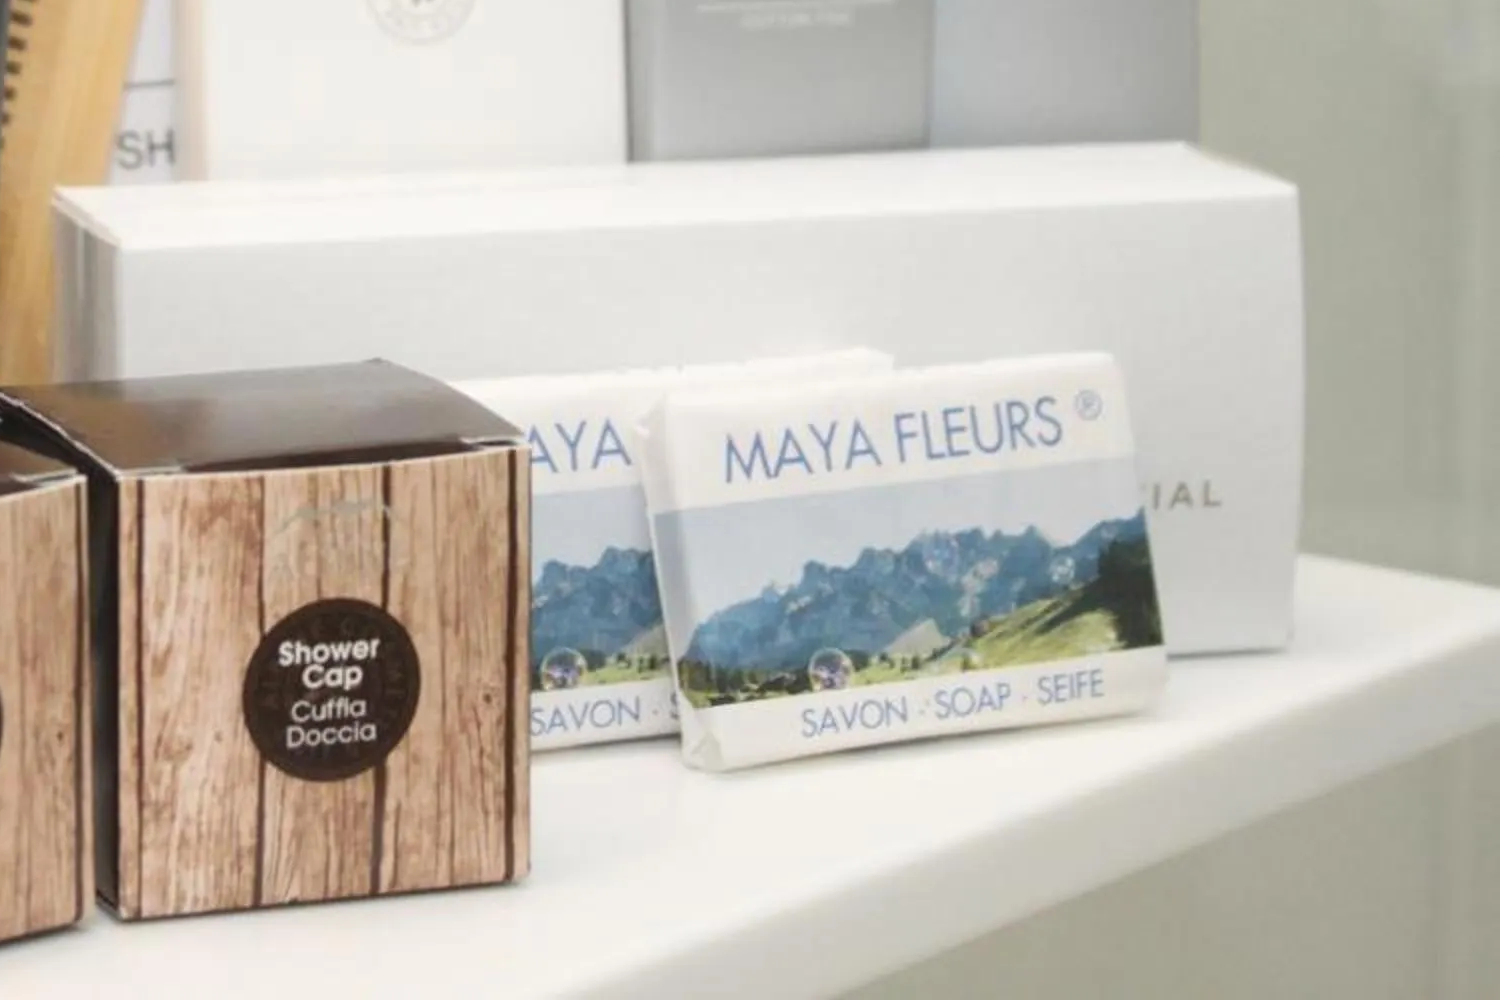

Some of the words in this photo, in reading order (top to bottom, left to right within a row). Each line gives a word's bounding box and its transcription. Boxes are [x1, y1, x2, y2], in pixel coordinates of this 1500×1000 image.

[724, 418, 882, 485] MAYA
[893, 395, 1064, 464] FLEURS
[1139, 479, 1223, 512] IAL
[277, 637, 381, 668] Shower
[301, 662, 364, 691] Cap
[529, 694, 642, 737] SAVON
[801, 695, 909, 739] SAVON
[934, 682, 1012, 720] SOAP
[1037, 668, 1105, 706] SEIFE
[285, 721, 378, 749] Doccia
